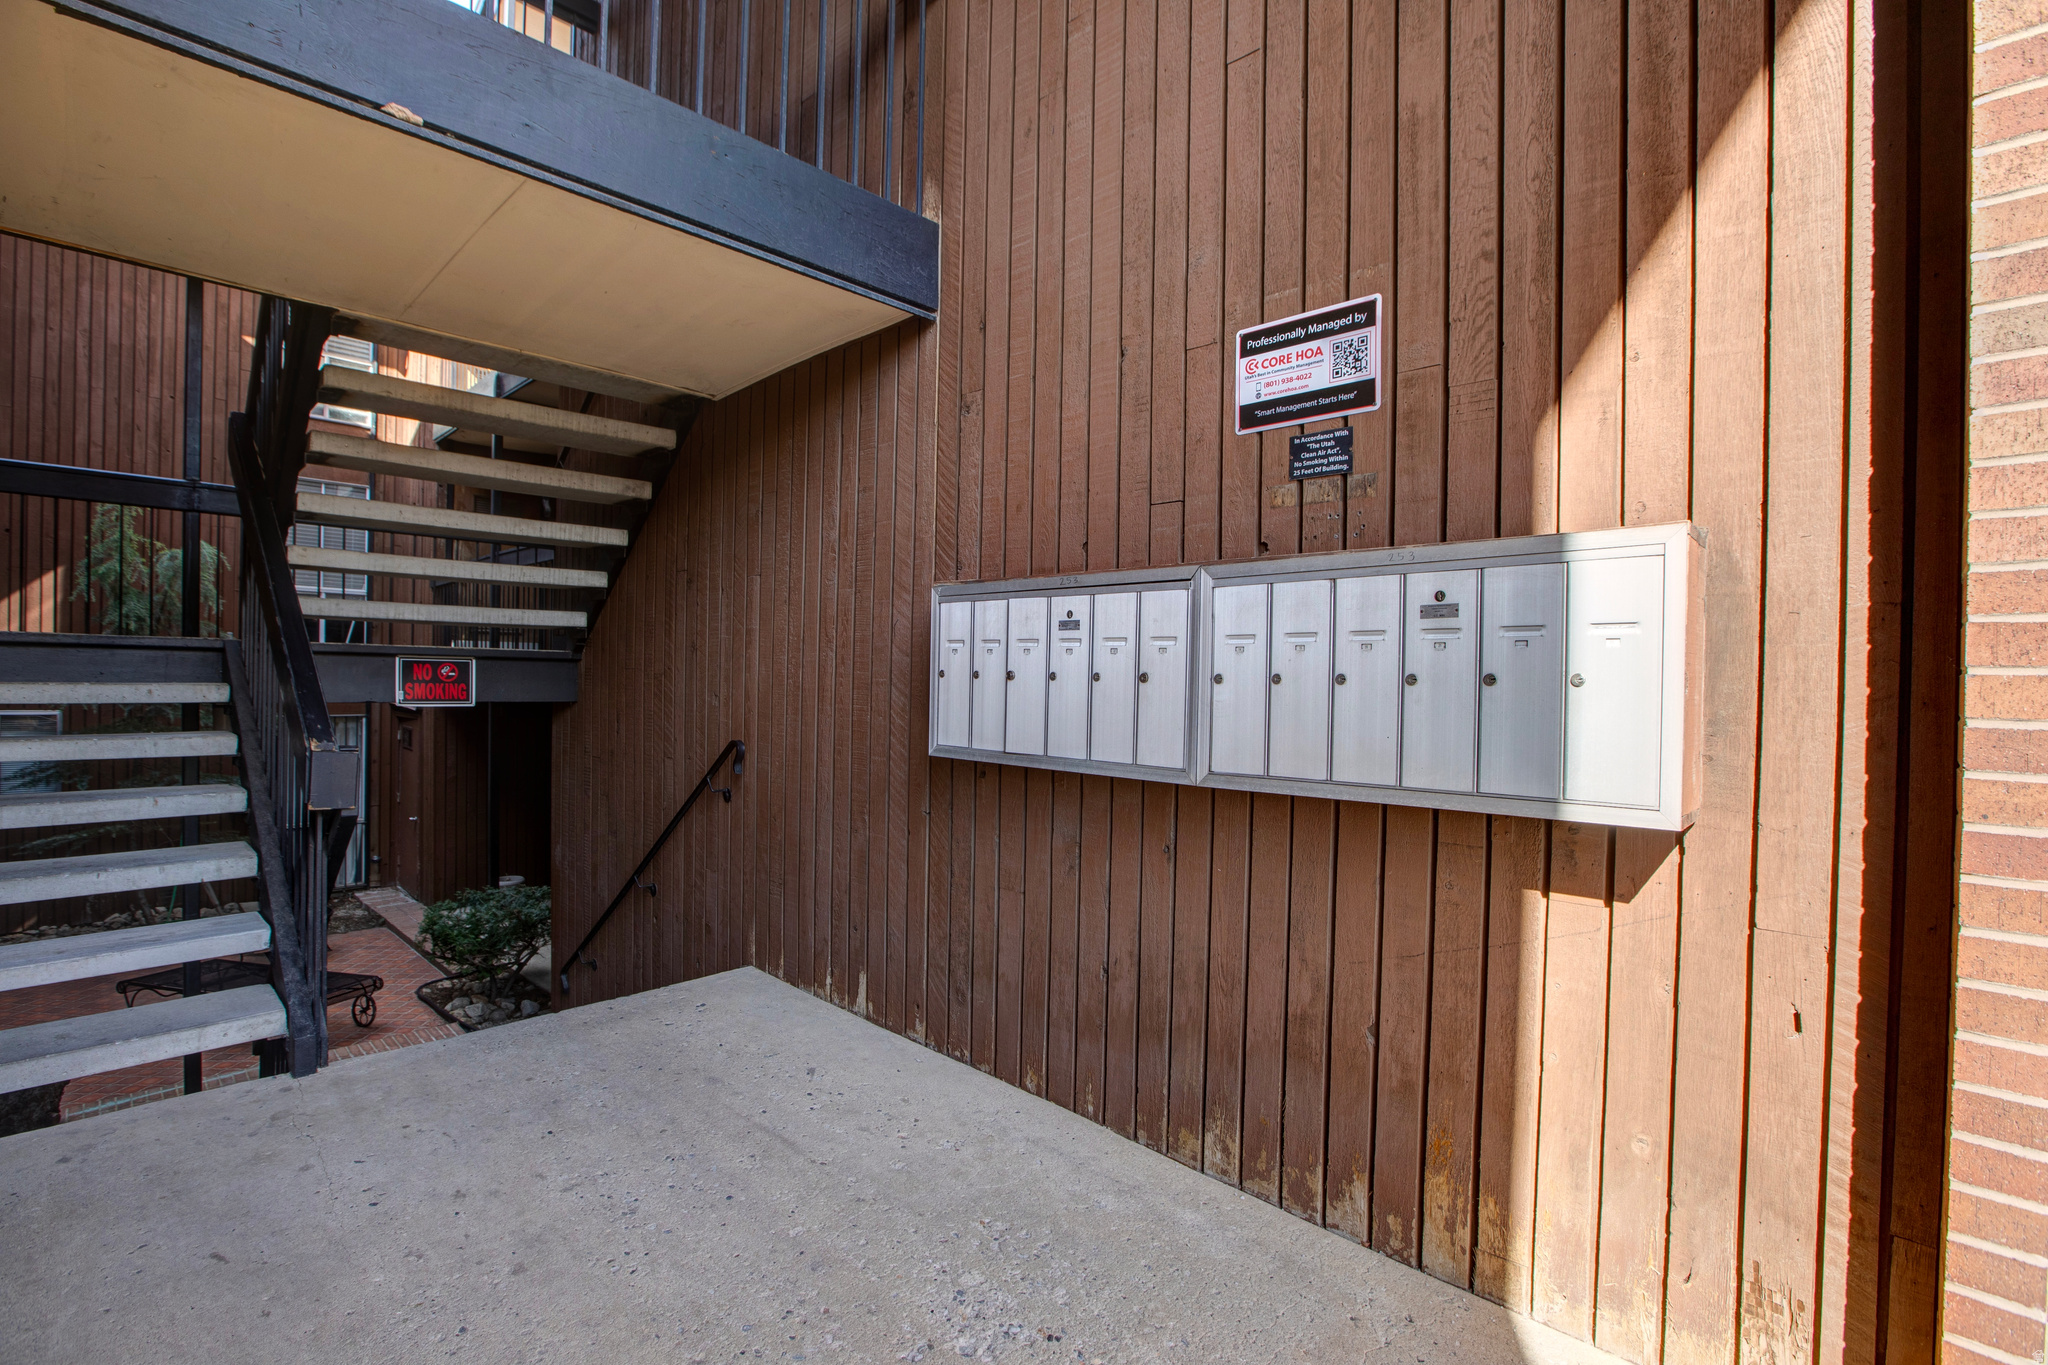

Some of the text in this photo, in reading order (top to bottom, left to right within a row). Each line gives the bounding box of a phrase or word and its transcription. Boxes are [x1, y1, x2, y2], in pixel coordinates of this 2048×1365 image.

[1247, 312, 1368, 350] Professionally Managed by
[1261, 346, 1324, 369] CORE HOA
[1271, 365, 1295, 374] Community
[1295, 359, 1325, 368] Management
[1263, 372, 1312, 389] (801) 938-4022
[1263, 384, 1310, 397] www.corehoa.com
[1254, 390, 1358, 417] "Smart Management Starts Here"
[1301, 433, 1334, 443] Accordance
[1303, 457, 1328, 466] Smoking
[1328, 454, 1349, 463] Within
[1322, 464, 1349, 472] Building.
[1387, 551, 1415, 562] 253
[1059, 576, 1079, 586] 253
[413, 663, 433, 681] NO
[404, 682, 467, 700] SMOKING
